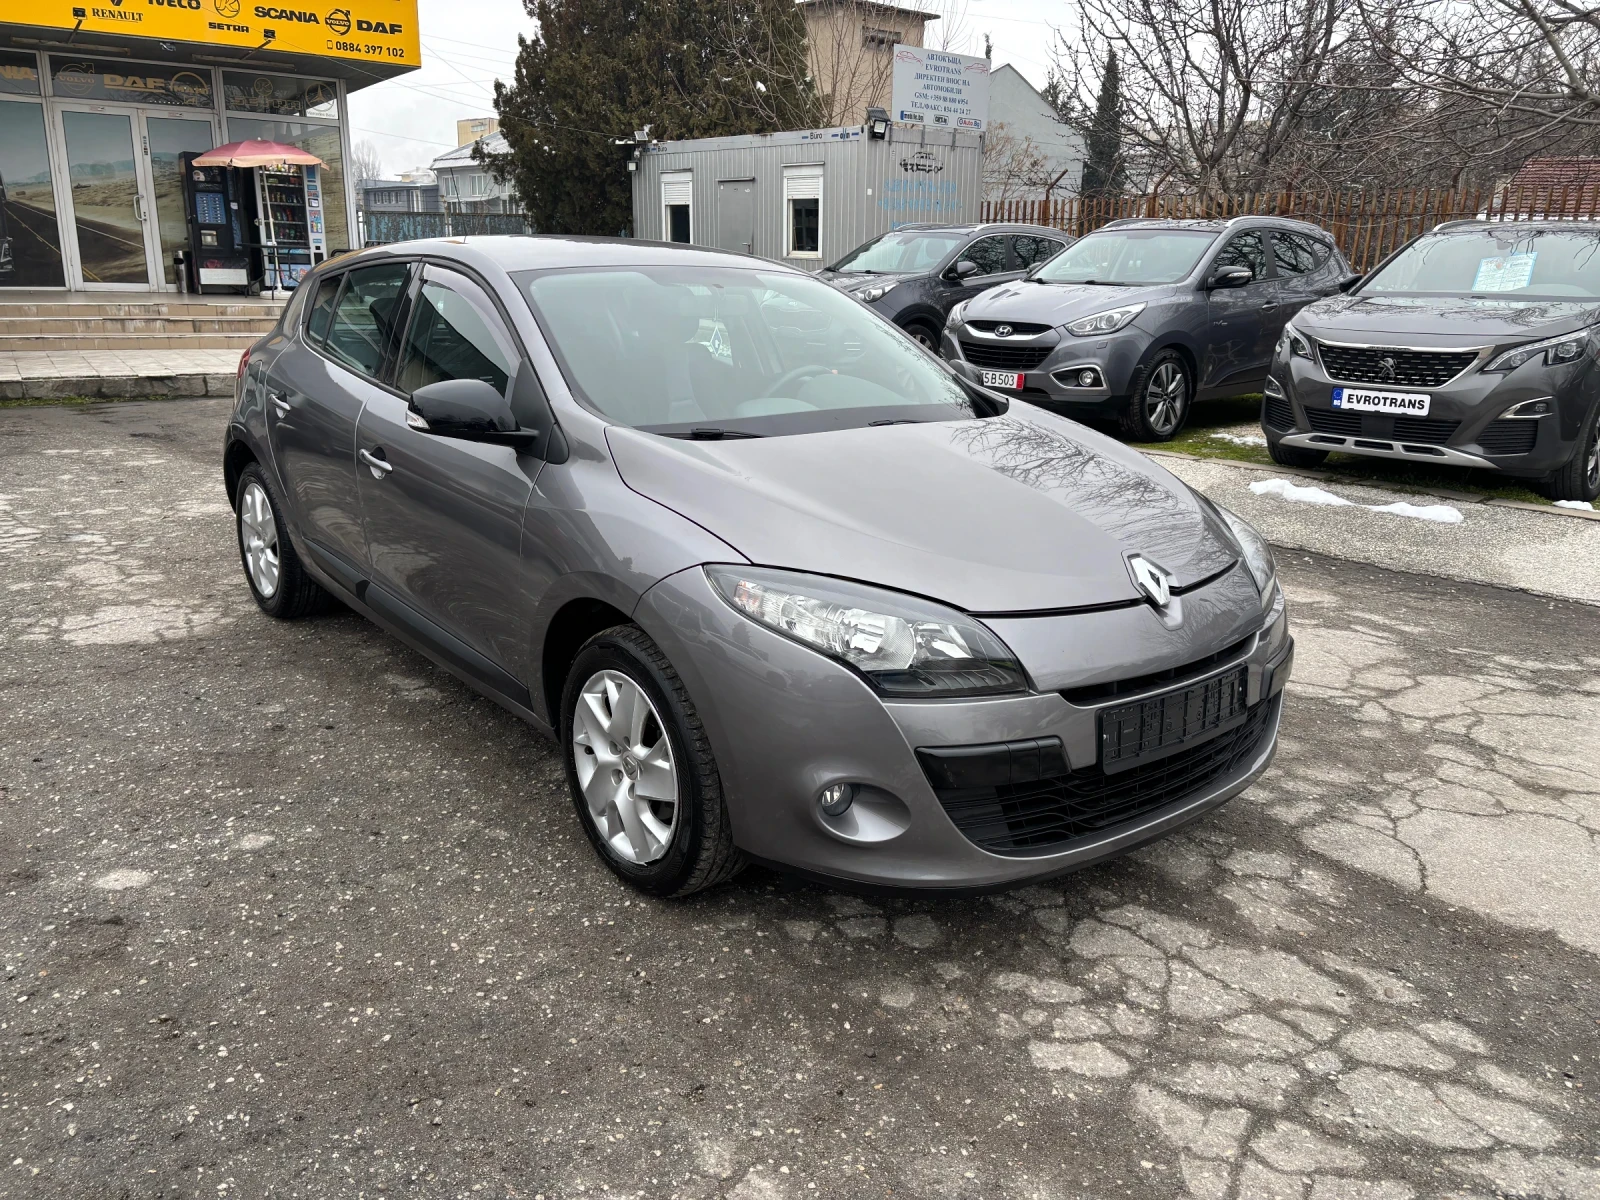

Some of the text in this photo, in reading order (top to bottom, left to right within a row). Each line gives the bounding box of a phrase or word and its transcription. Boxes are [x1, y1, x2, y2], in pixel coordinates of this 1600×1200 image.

[92, 8, 143, 21] RENAULT
[254, 6, 320, 24] SCANIA
[208, 22, 249, 33] SETRA
[357, 20, 402, 34] DAF
[336, 41, 404, 57] 0884 397 102
[925, 63, 961, 75] EVROTRANS
[58, 75, 95, 84] VOLVO
[103, 74, 165, 88] DAF
[914, 72, 944, 82] ДИРЕКТЕН
[1347, 393, 1425, 410] EVROTRANS
